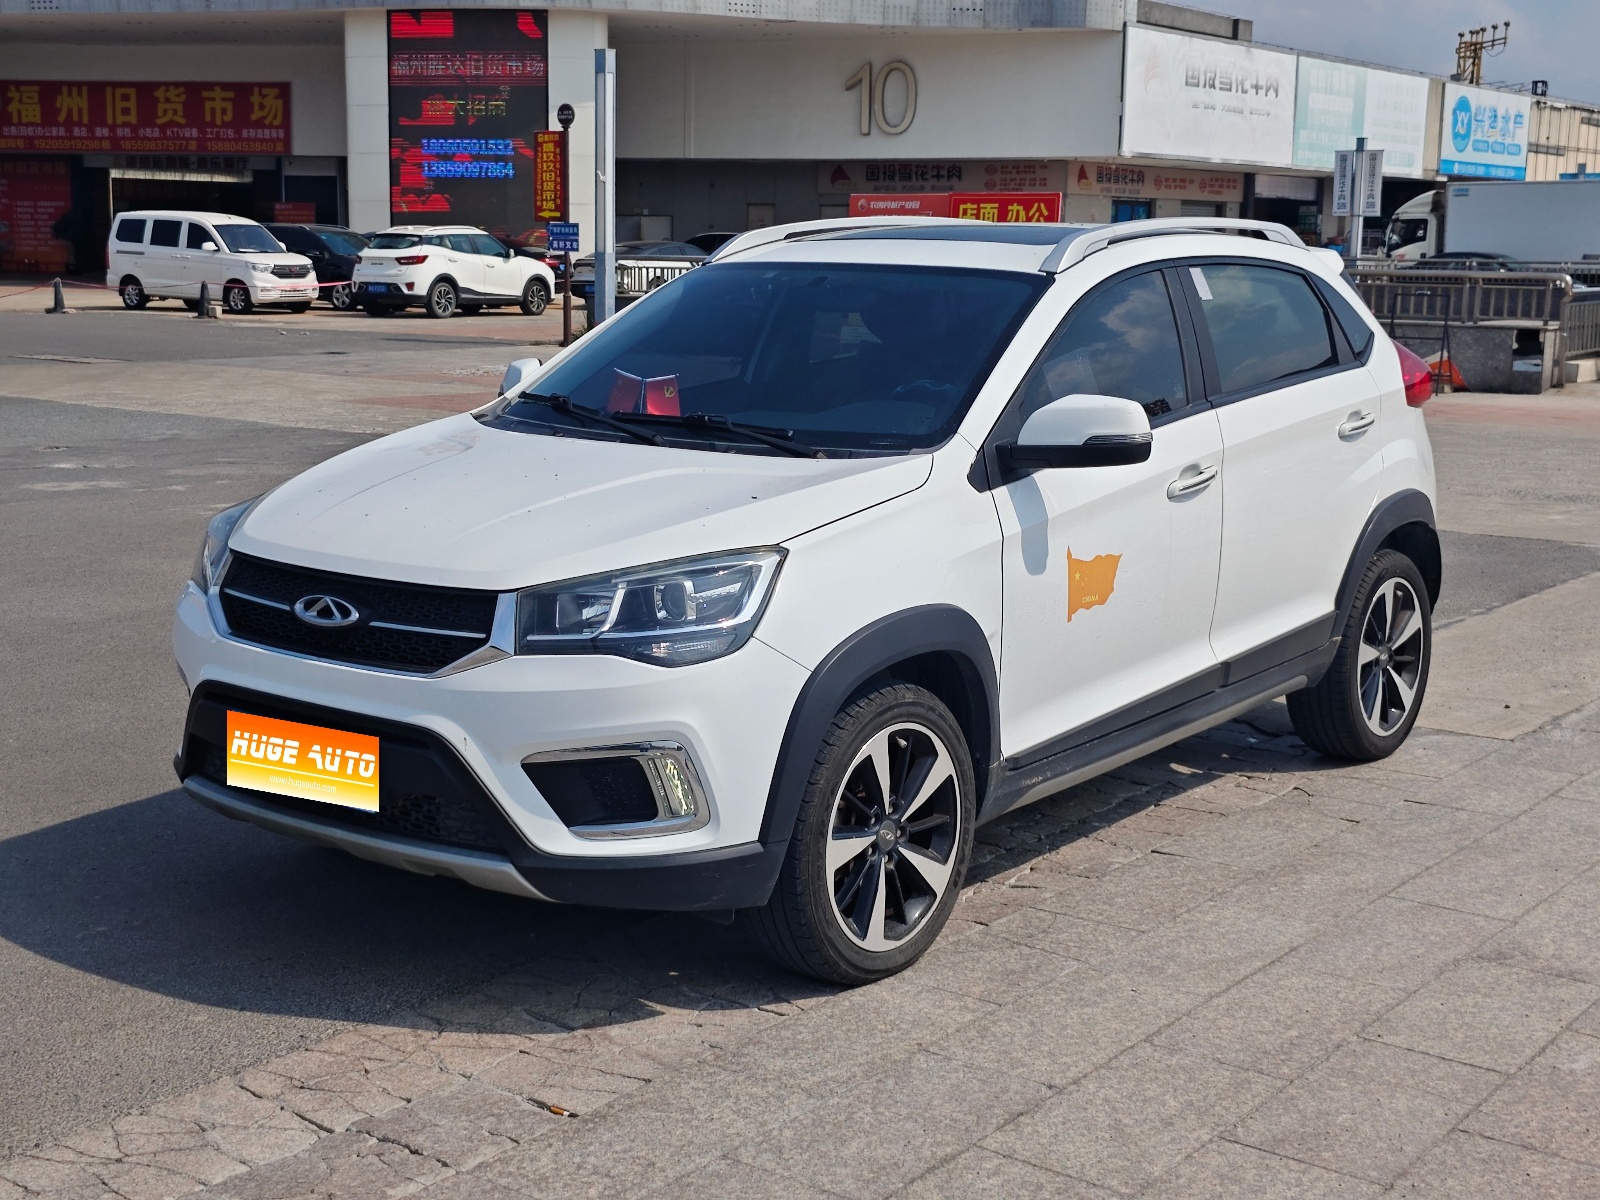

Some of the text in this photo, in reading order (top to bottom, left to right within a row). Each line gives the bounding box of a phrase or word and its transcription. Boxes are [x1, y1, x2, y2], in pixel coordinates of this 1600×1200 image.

[7, 84, 285, 126] 福州旧货市场
[845, 60, 917, 136] 10
[866, 164, 962, 182] 国投雪花牛肉
[1096, 165, 1145, 186] 国投雪花牛肉
[959, 203, 1049, 222] 店面 办公
[1082, 594, 1099, 603] CHINA
